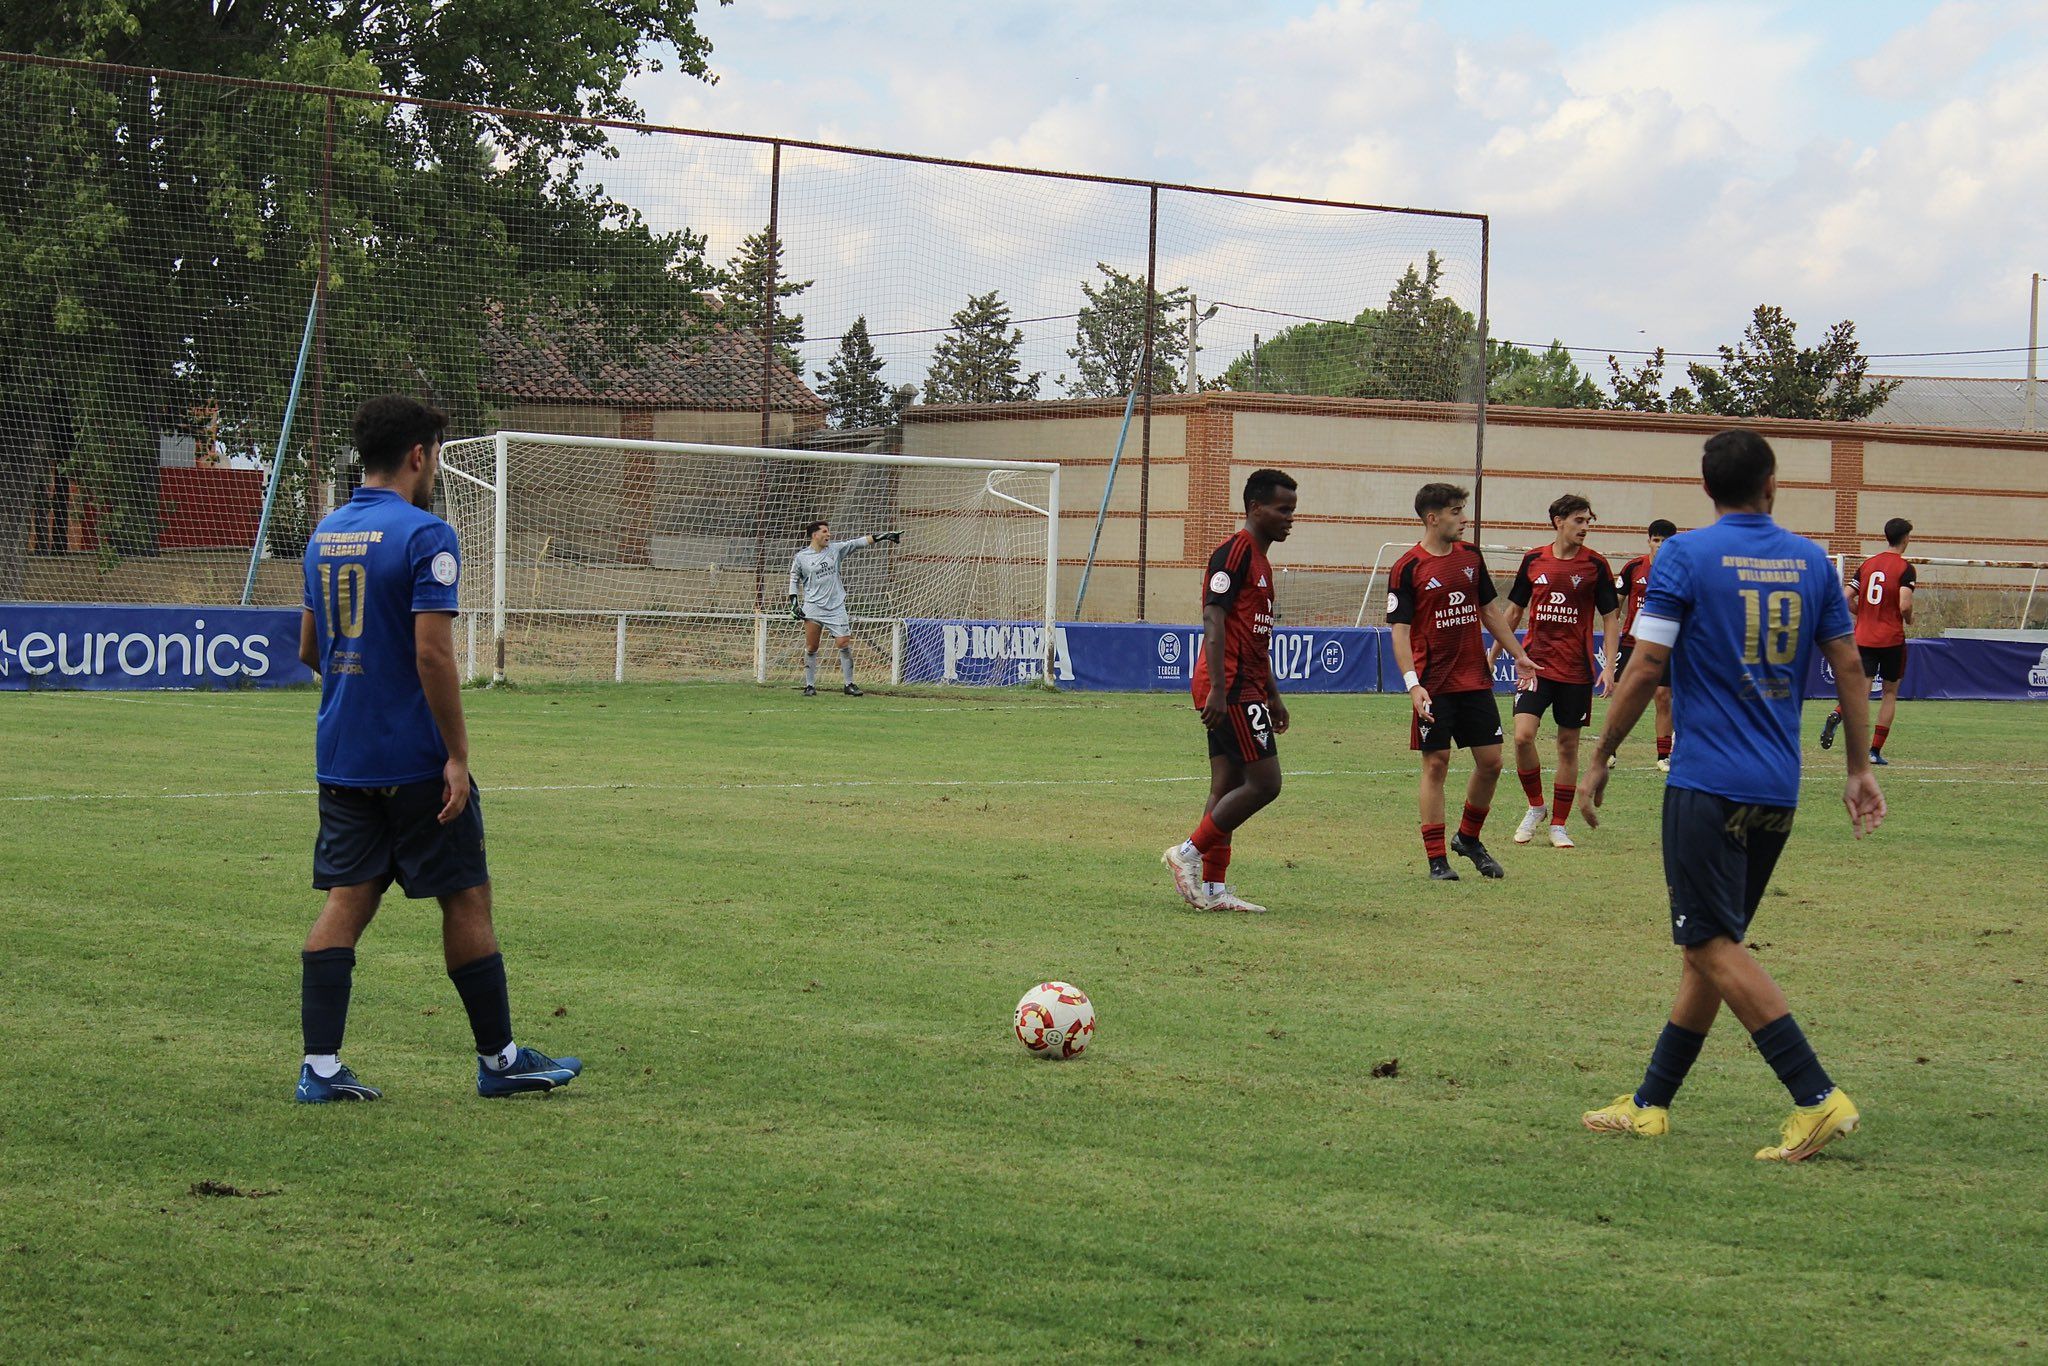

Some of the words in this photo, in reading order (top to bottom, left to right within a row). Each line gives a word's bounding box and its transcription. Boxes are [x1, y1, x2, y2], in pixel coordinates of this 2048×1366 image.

[369, 531, 383, 543] DE
[317, 563, 366, 638] 10
[1866, 571, 1885, 606] 6
[1436, 614, 1478, 629] EMPRESAS
[1536, 613, 1578, 625] EMPRESAS
[1537, 604, 1579, 615] MIRANDA
[1738, 589, 1802, 665] 18
[18, 619, 270, 677] euronics
